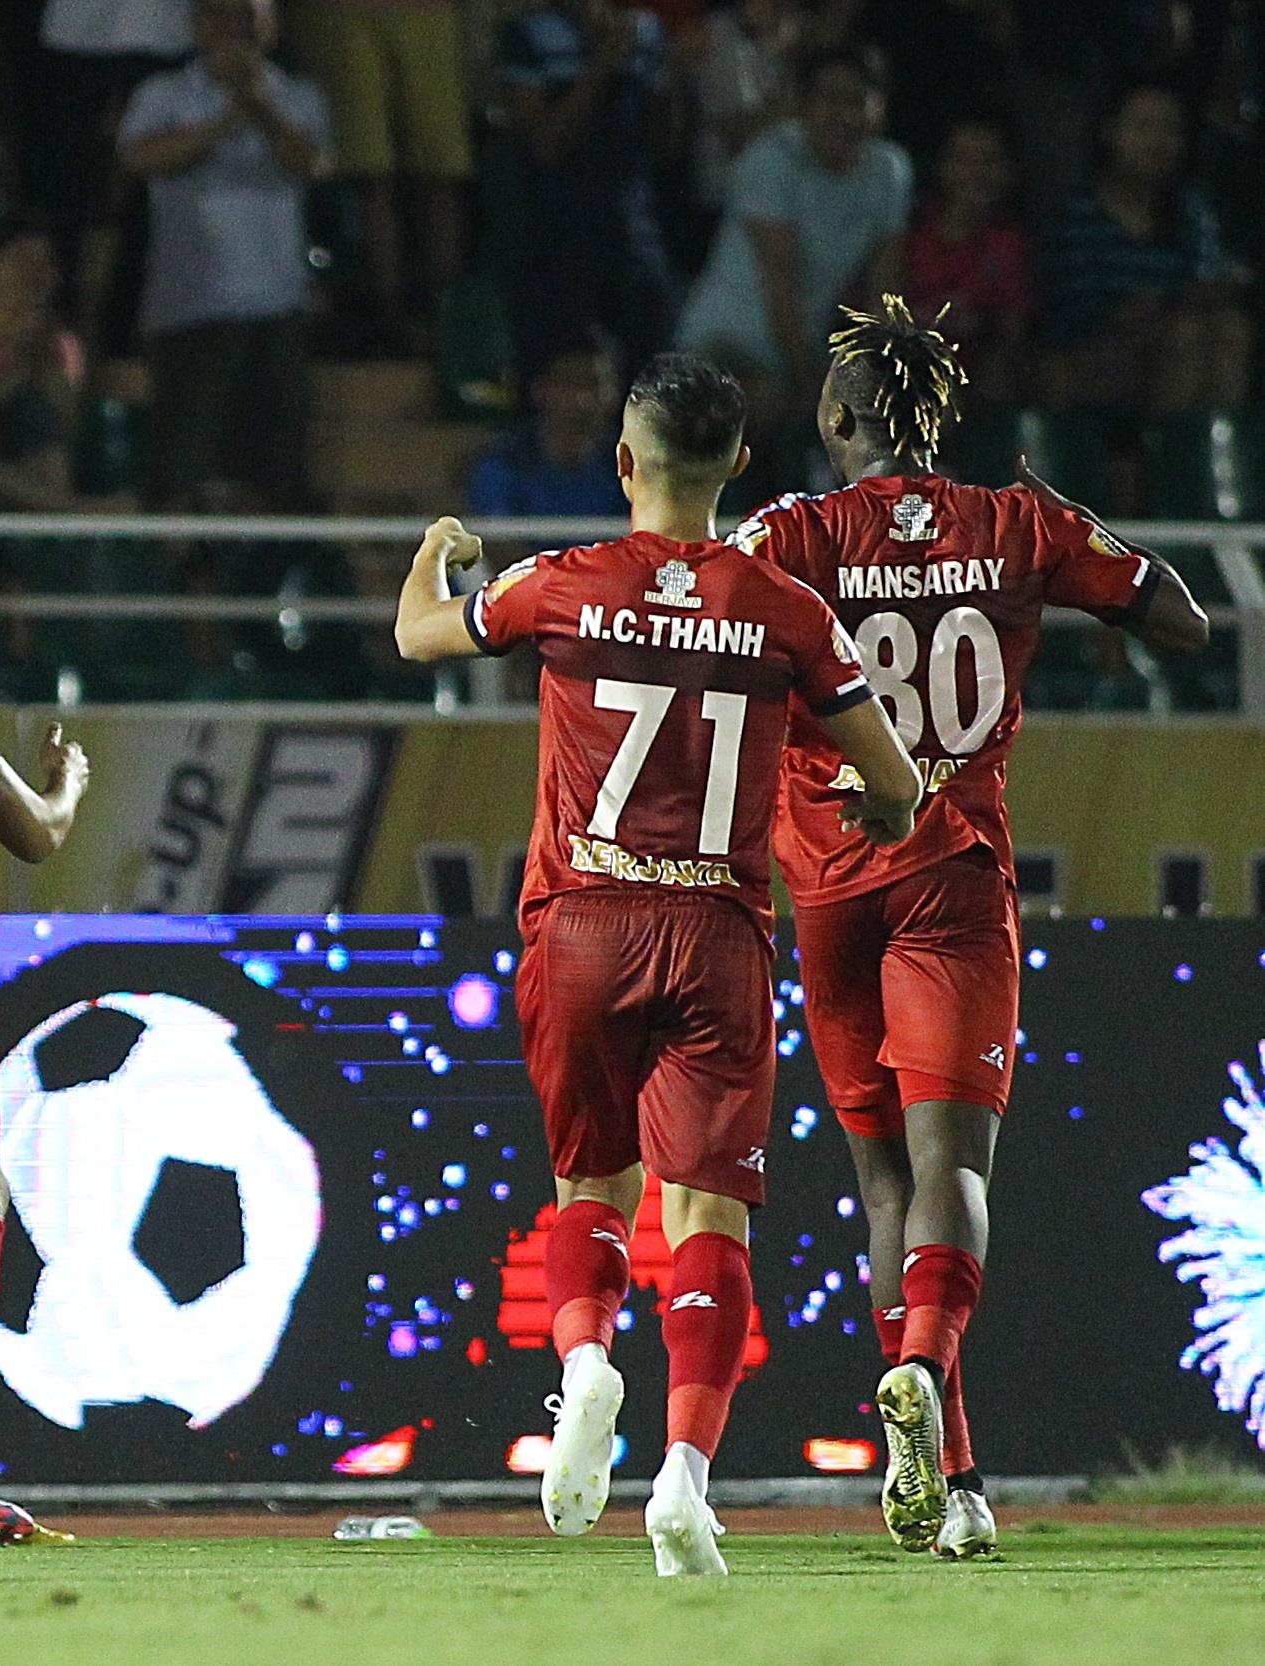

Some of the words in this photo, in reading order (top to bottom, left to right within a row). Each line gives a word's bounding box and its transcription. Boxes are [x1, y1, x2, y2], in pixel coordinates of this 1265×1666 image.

[837, 558, 1005, 599] MANSARAY
[578, 603, 765, 657] N.C.THANH
[854, 606, 1005, 755] 80
[586, 677, 747, 855] 71
[567, 834, 740, 888] BERJAYA
